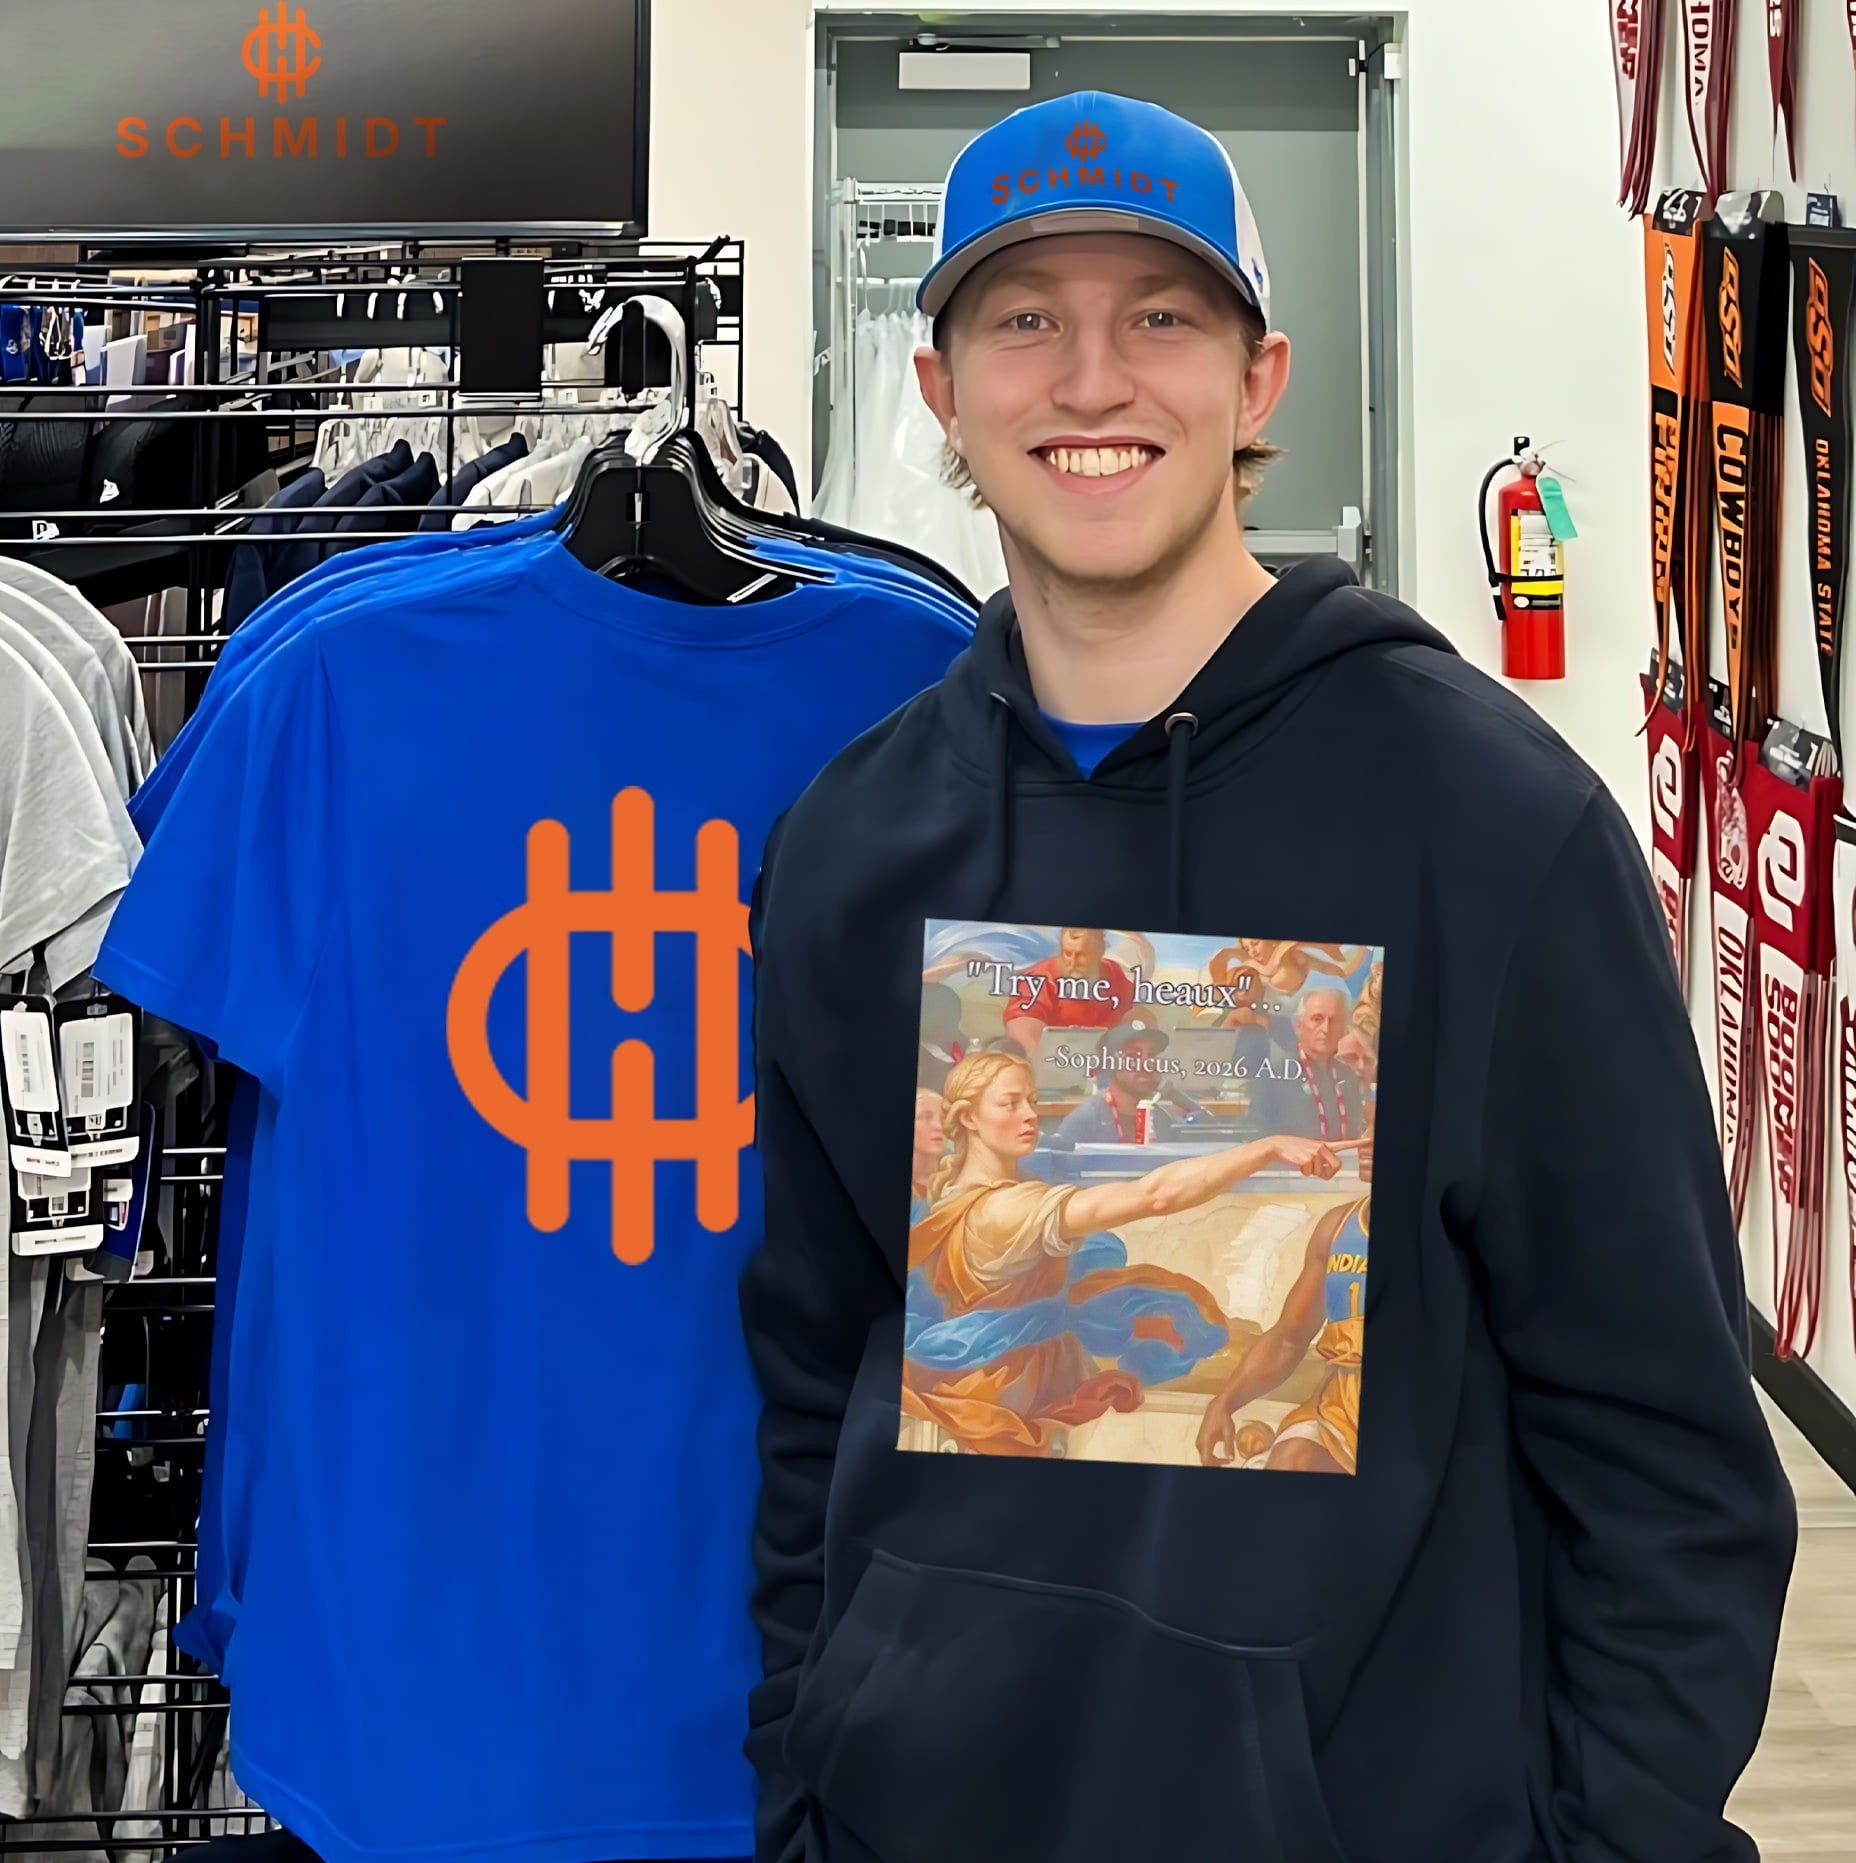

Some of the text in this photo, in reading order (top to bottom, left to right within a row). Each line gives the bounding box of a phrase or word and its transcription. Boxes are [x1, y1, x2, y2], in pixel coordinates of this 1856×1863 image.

[115, 117, 448, 158] SCHMIDT
[991, 166, 1179, 204] SCHMIDT
[1815, 438, 1831, 570] OKLAHOMA
[967, 961, 1046, 1010] "Try
[1056, 975, 1120, 1009] me,
[1718, 926, 1745, 1143] OKLAHOMA
[1194, 1055, 1248, 1078] 2026
[1255, 1057, 1308, 1082] A.D.
